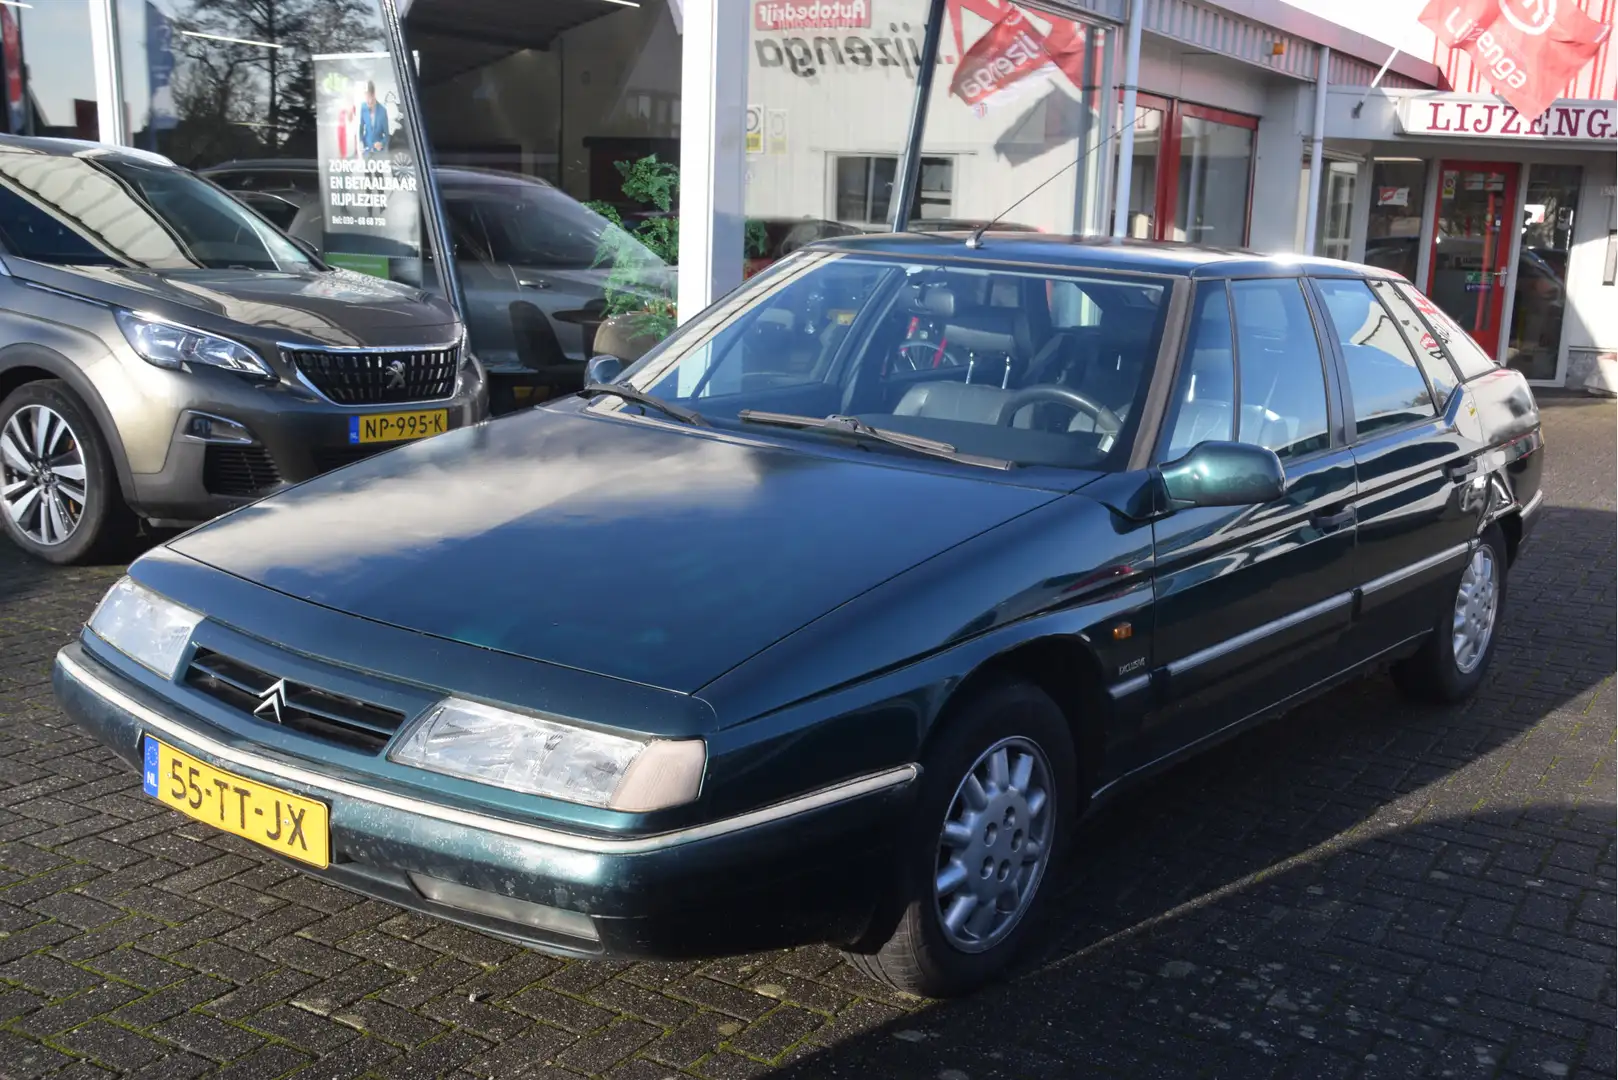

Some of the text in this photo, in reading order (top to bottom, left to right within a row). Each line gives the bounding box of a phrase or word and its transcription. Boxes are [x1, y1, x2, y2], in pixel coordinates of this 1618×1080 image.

[1444, 6, 1527, 89] Lijzenga
[1426, 102, 1617, 138] LIJZENG
[328, 159, 392, 173] ZORGELOOS
[330, 176, 417, 191] EN BETAALBAAR
[331, 192, 387, 208] RIJPLEZIER
[364, 413, 442, 438] NP-995-K
[146, 771, 157, 787] NL
[171, 757, 308, 851] 55-TT-JX
